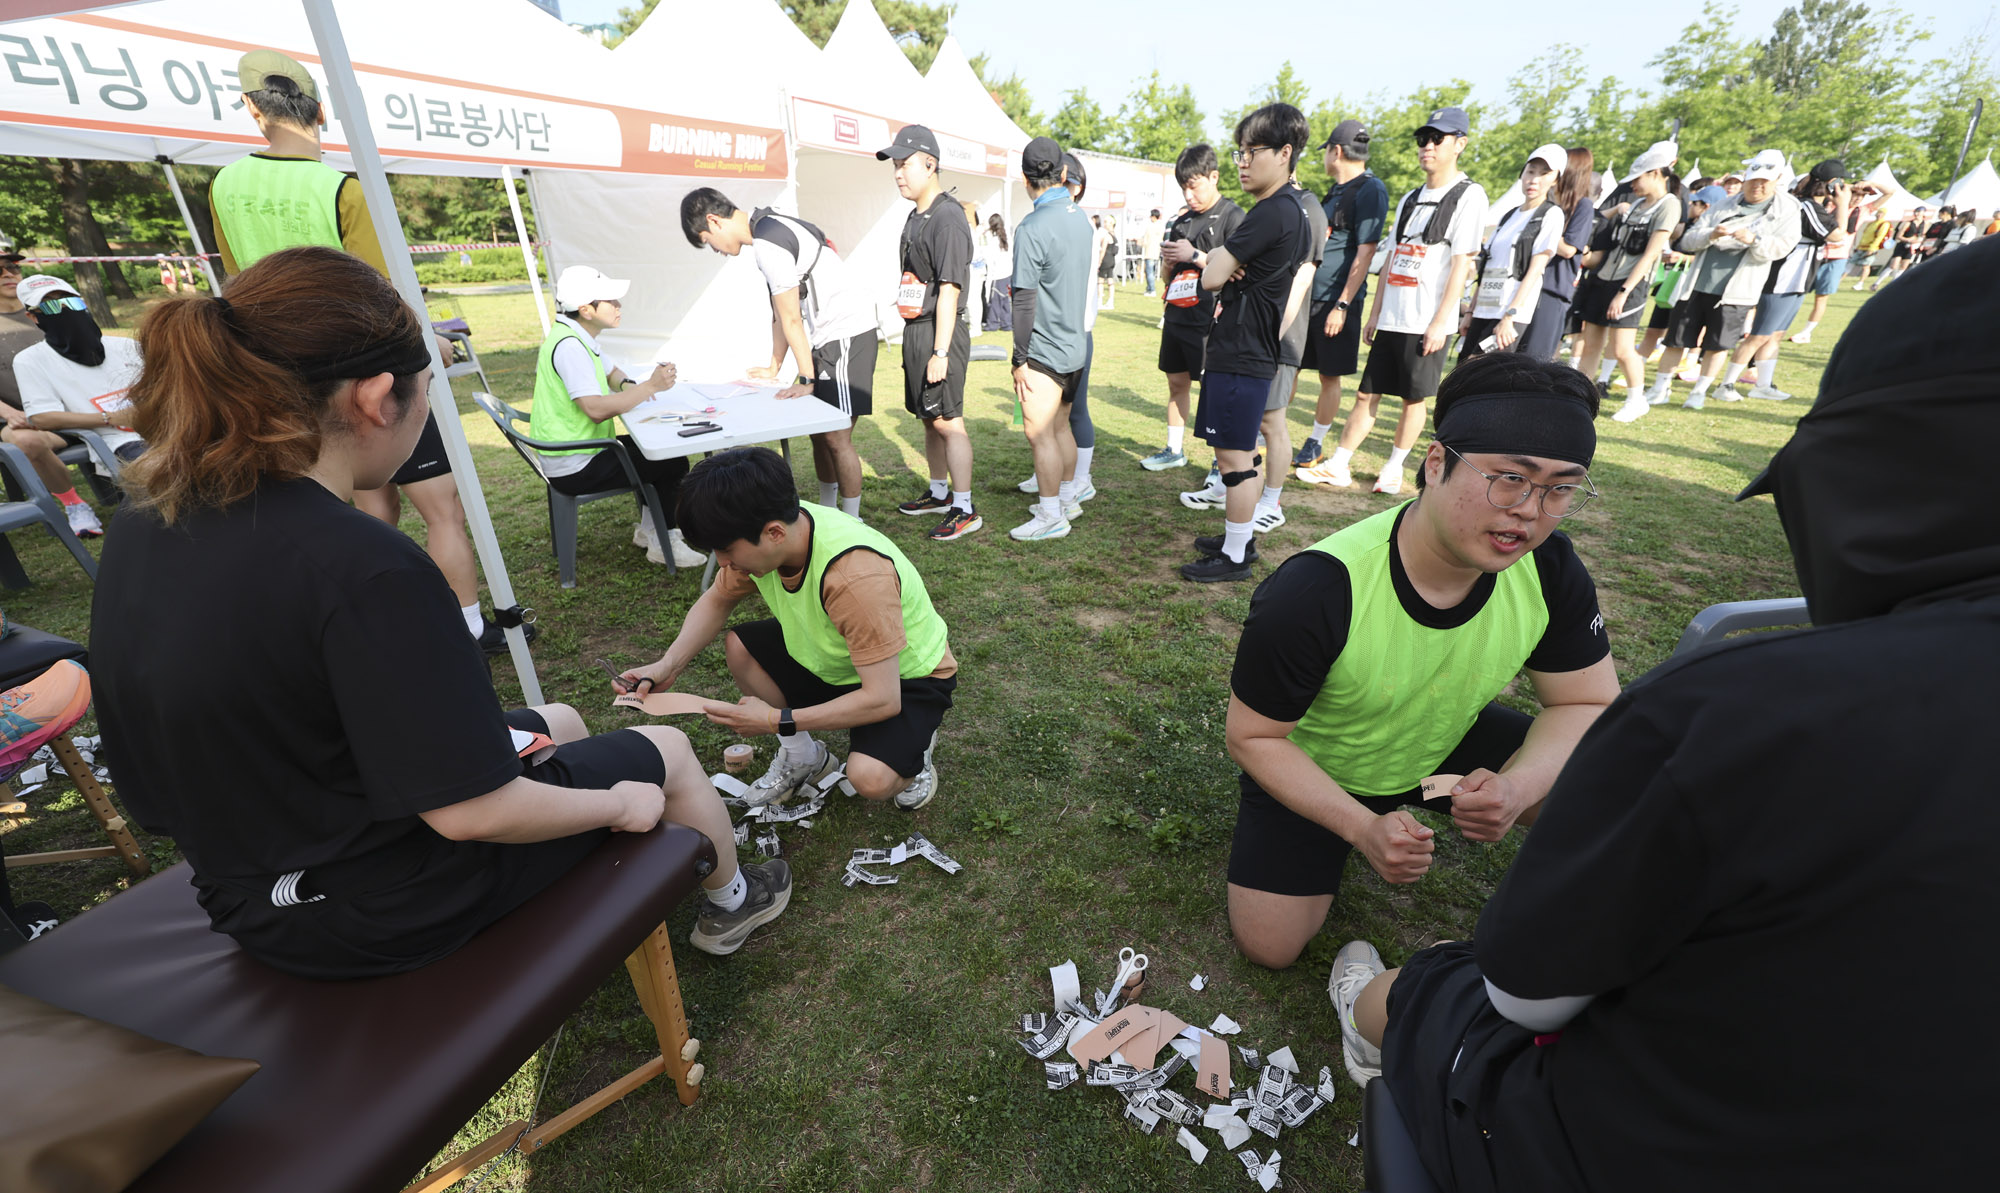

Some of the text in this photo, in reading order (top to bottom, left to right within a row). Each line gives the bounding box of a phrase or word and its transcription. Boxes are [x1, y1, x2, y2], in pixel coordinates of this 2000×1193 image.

[0, 33, 148, 111] 러닝
[384, 93, 552, 152] 의료봉사단
[648, 123, 768, 160] BURNING RUN
[694, 159, 766, 173] Casual Running Festival
[227, 194, 310, 220] STAFF
[1398, 259, 1421, 270] 2570
[1108, 1018, 1131, 1039] ROCKTAPE
